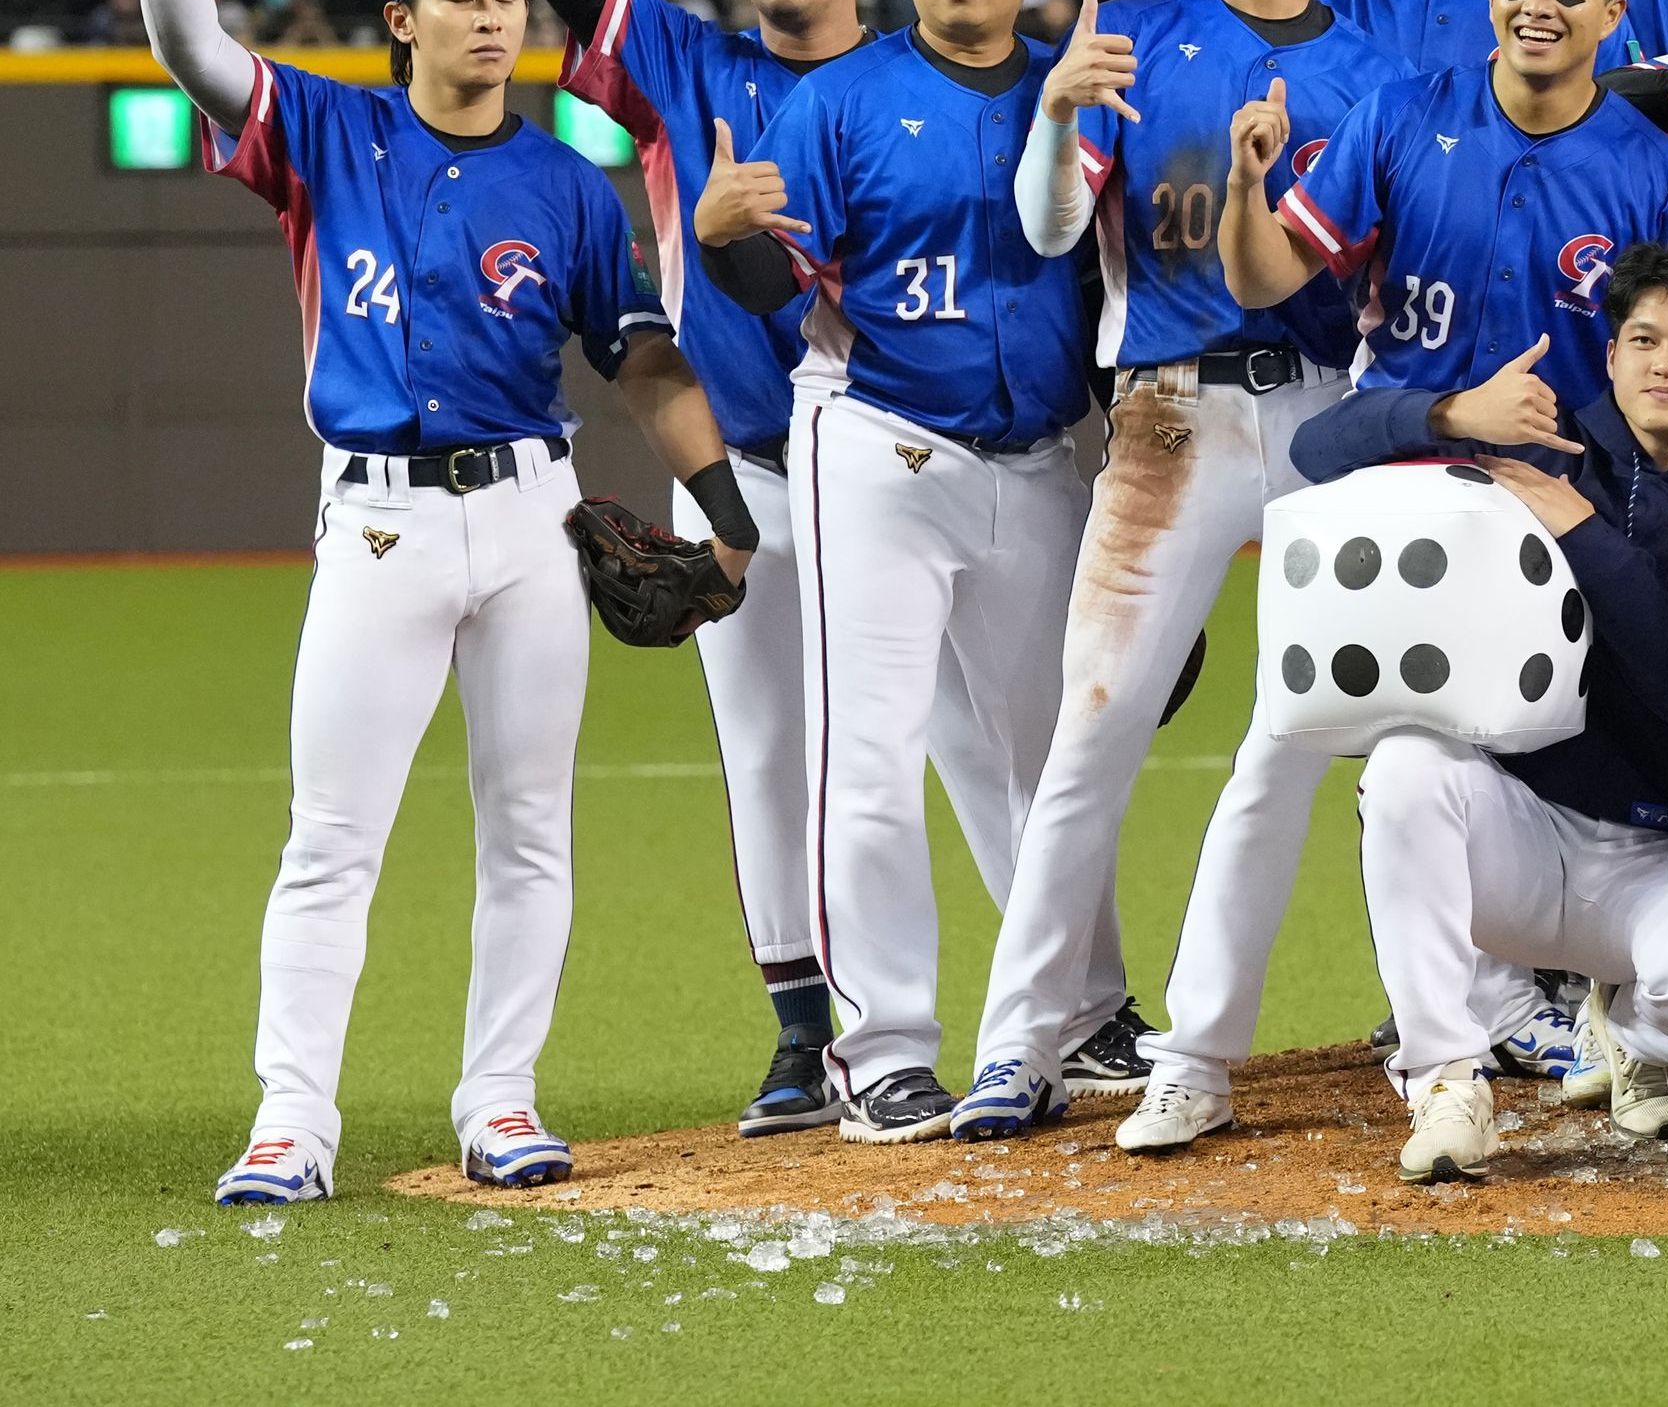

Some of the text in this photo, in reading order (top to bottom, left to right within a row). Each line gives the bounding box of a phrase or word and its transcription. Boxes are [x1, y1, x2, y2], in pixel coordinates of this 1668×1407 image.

[1152, 182, 1214, 251] 20
[346, 249, 400, 324] 24
[895, 255, 967, 321] 31
[1391, 274, 1455, 350] 39
